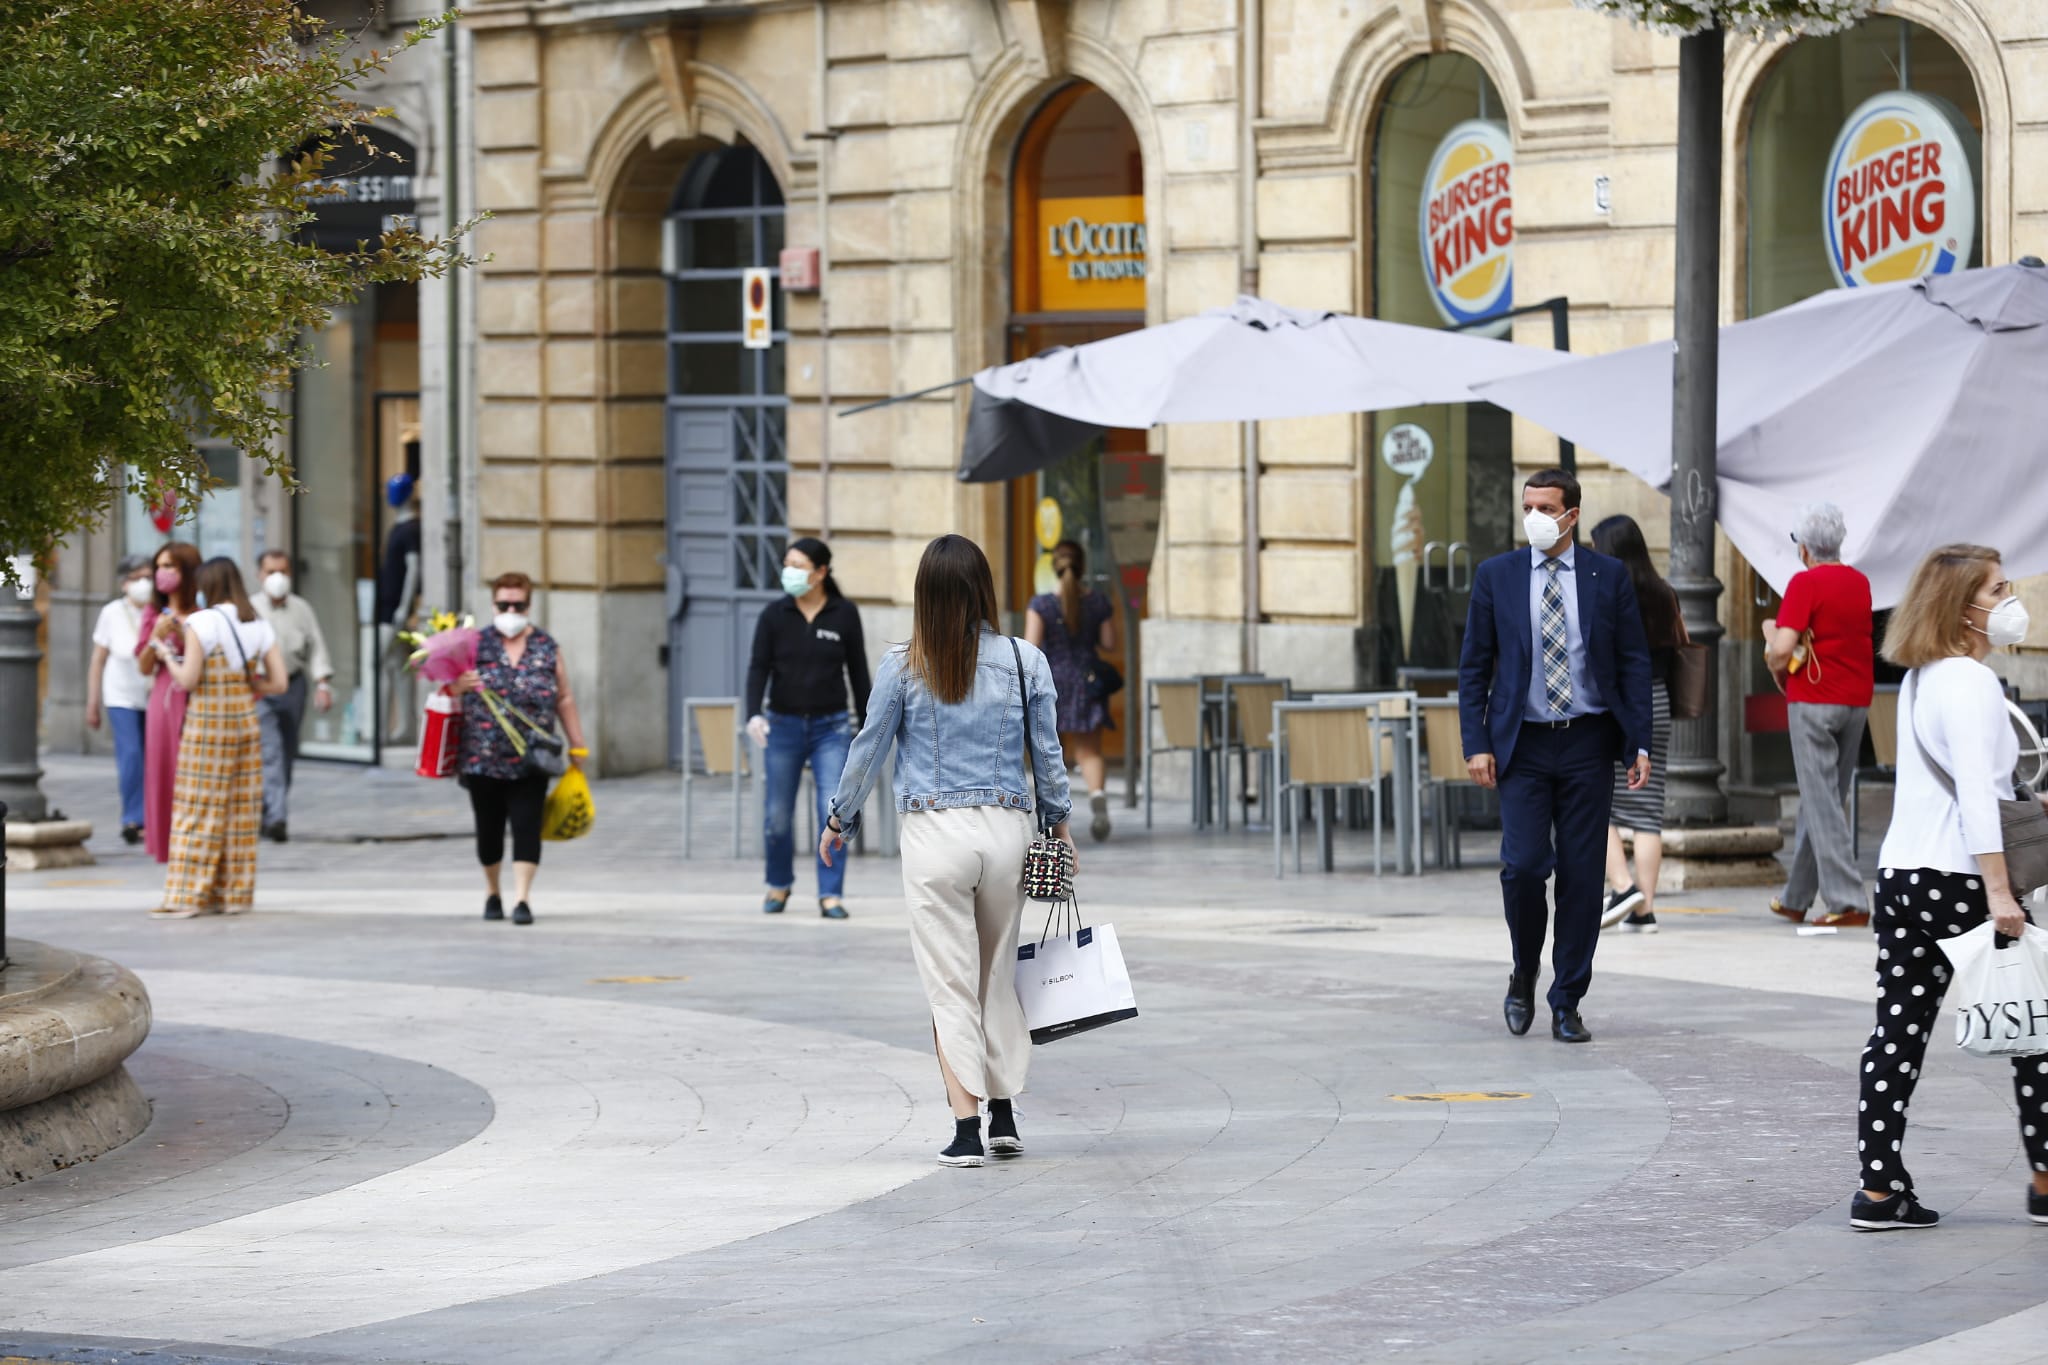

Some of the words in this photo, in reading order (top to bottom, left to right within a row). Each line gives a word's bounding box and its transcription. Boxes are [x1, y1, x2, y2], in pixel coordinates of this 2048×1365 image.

[1429, 162, 1510, 237] BURGER
[1837, 141, 1942, 219] BURGER
[1433, 197, 1512, 288] KING
[1841, 179, 1945, 273] KING
[1048, 972, 1074, 985] SILBON
